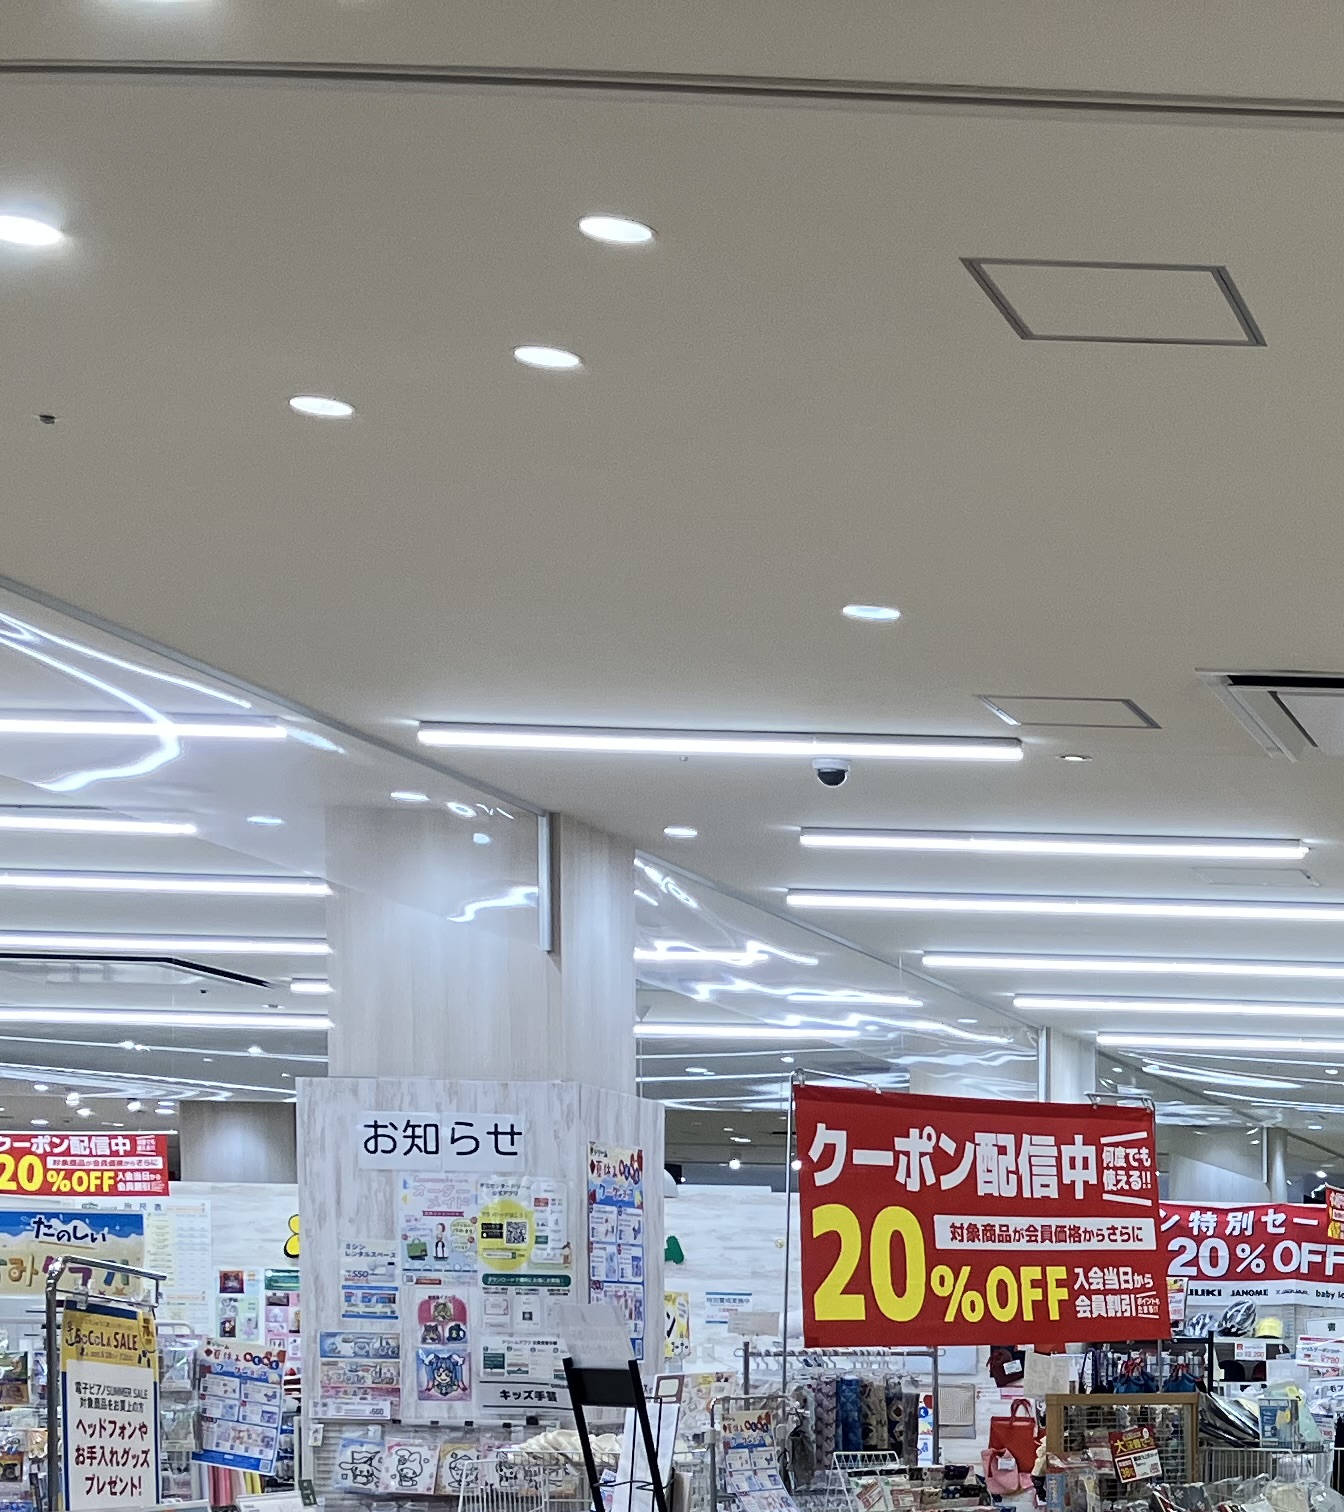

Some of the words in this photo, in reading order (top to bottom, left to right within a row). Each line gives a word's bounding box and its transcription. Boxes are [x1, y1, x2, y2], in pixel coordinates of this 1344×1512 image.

[363, 1119, 523, 1156] お知らせ
[808, 1122, 1098, 1200] クーポン配信中
[1102, 1146, 1151, 1169] 何度でも
[32, 1216, 107, 1243] たのしい
[949, 1222, 1144, 1245] 対象商品が会員価格からさらに
[811, 1203, 1070, 1323] 20%OFF
[1073, 1266, 1154, 1291] 入会当日から
[1230, 1288, 1269, 1297] JANOME
[1315, 1289, 1335, 1300] baby
[1075, 1294, 1135, 1319] 会員割引
[113, 1331, 138, 1351] SALE
[76, 1417, 148, 1441] ヘッドフォンや
[74, 1445, 151, 1469] お手入れグッズ
[85, 1474, 142, 1496] プレゼント!
